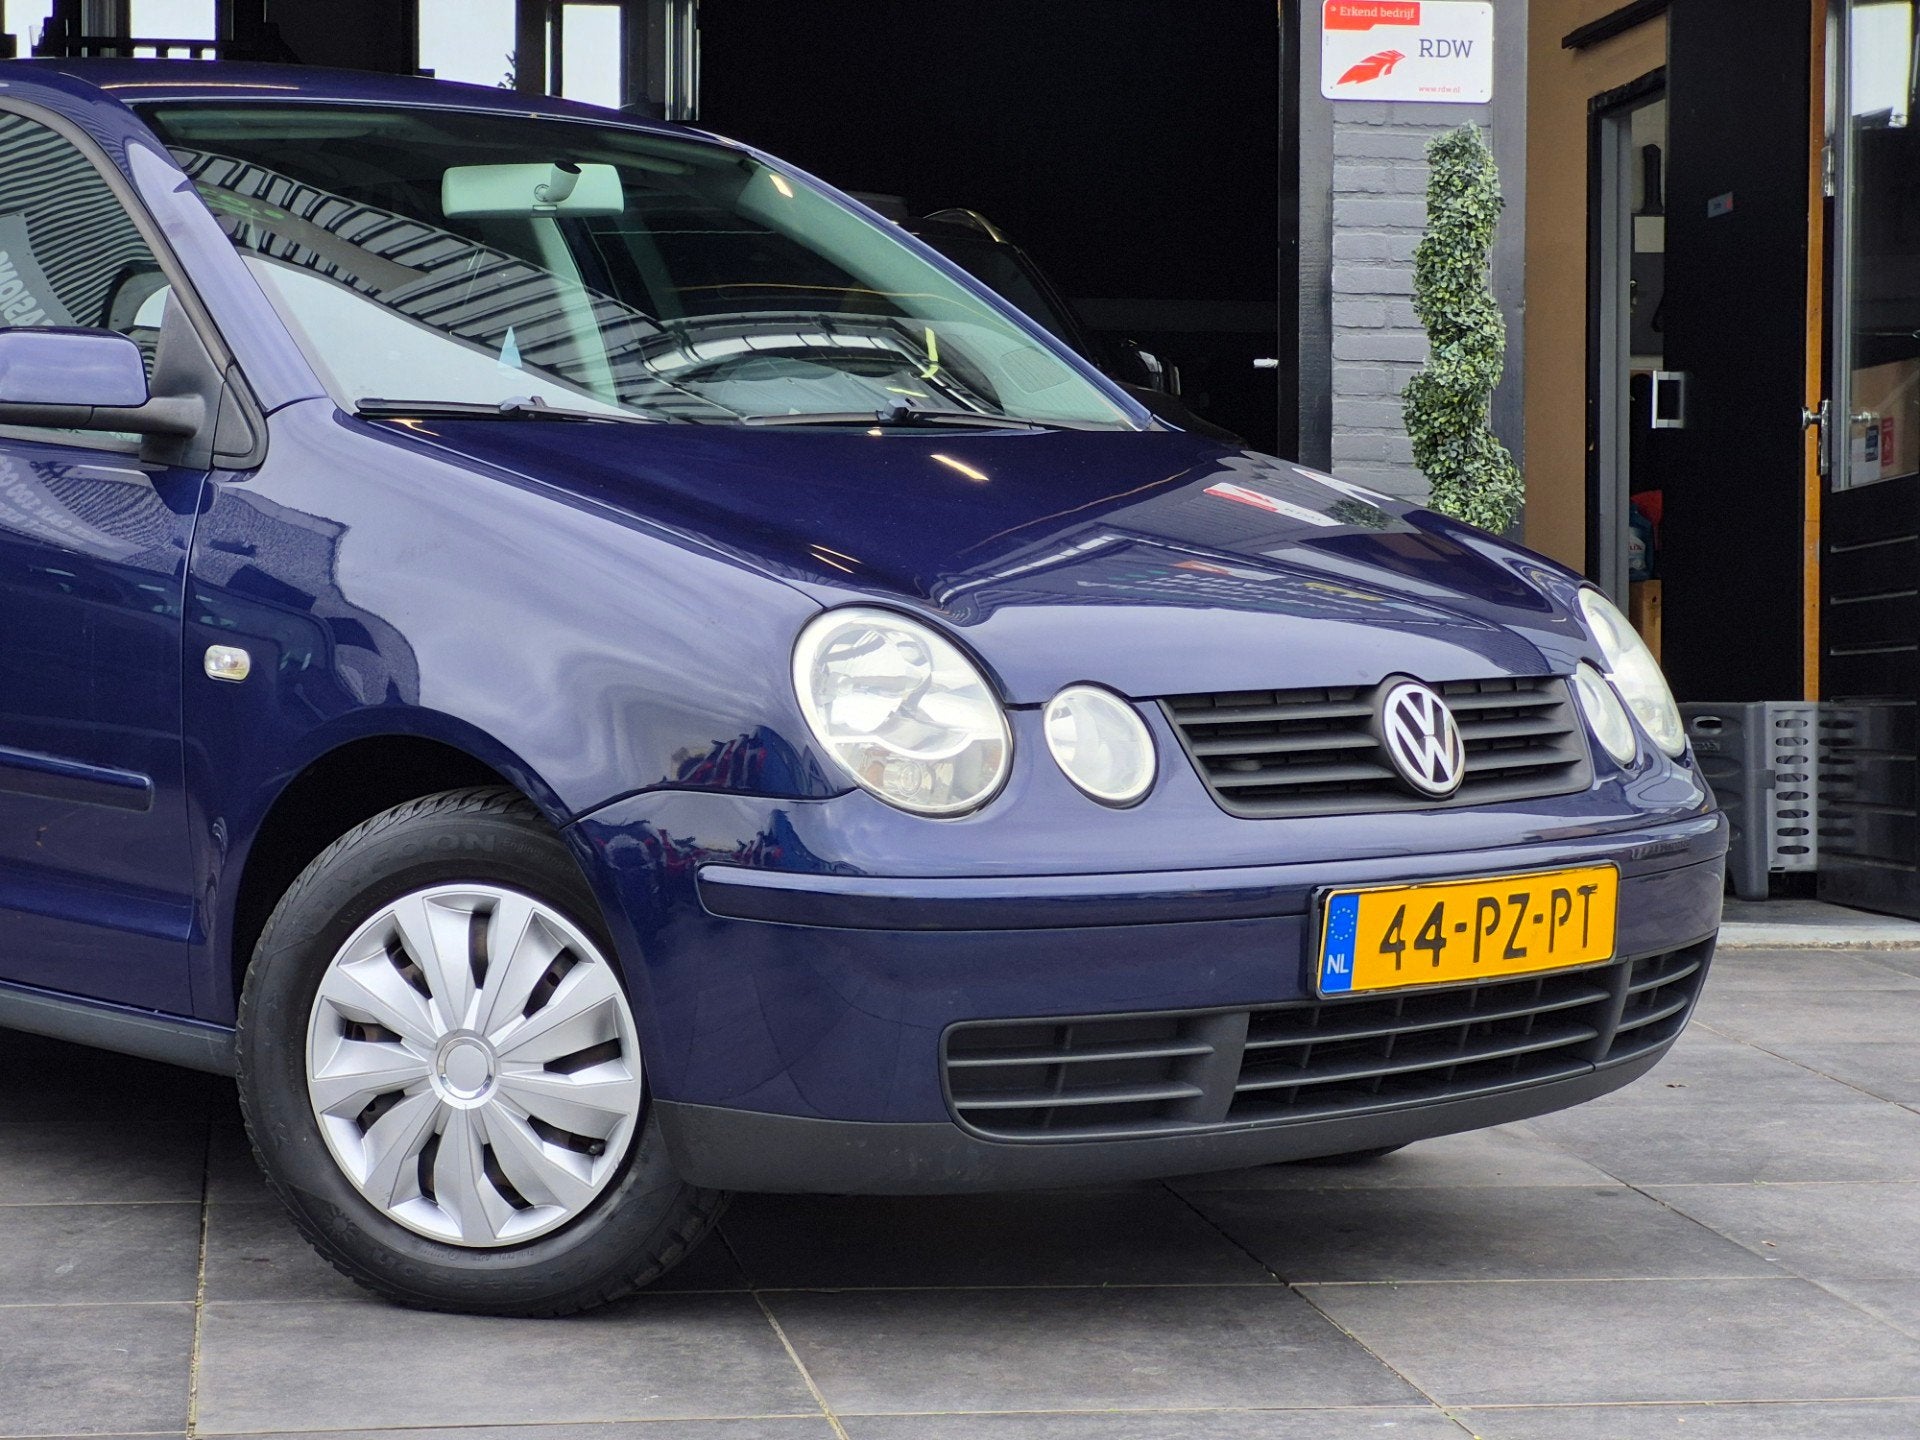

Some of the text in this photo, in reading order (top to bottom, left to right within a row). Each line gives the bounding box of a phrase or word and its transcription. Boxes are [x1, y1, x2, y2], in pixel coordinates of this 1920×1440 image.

[1339, 6, 1415, 19] Erkend bedrijf
[1418, 38, 1474, 59] RDW
[1418, 85, 1461, 94] www.rdw.nl
[1327, 883, 1599, 975] NL 44-PZ-PT
